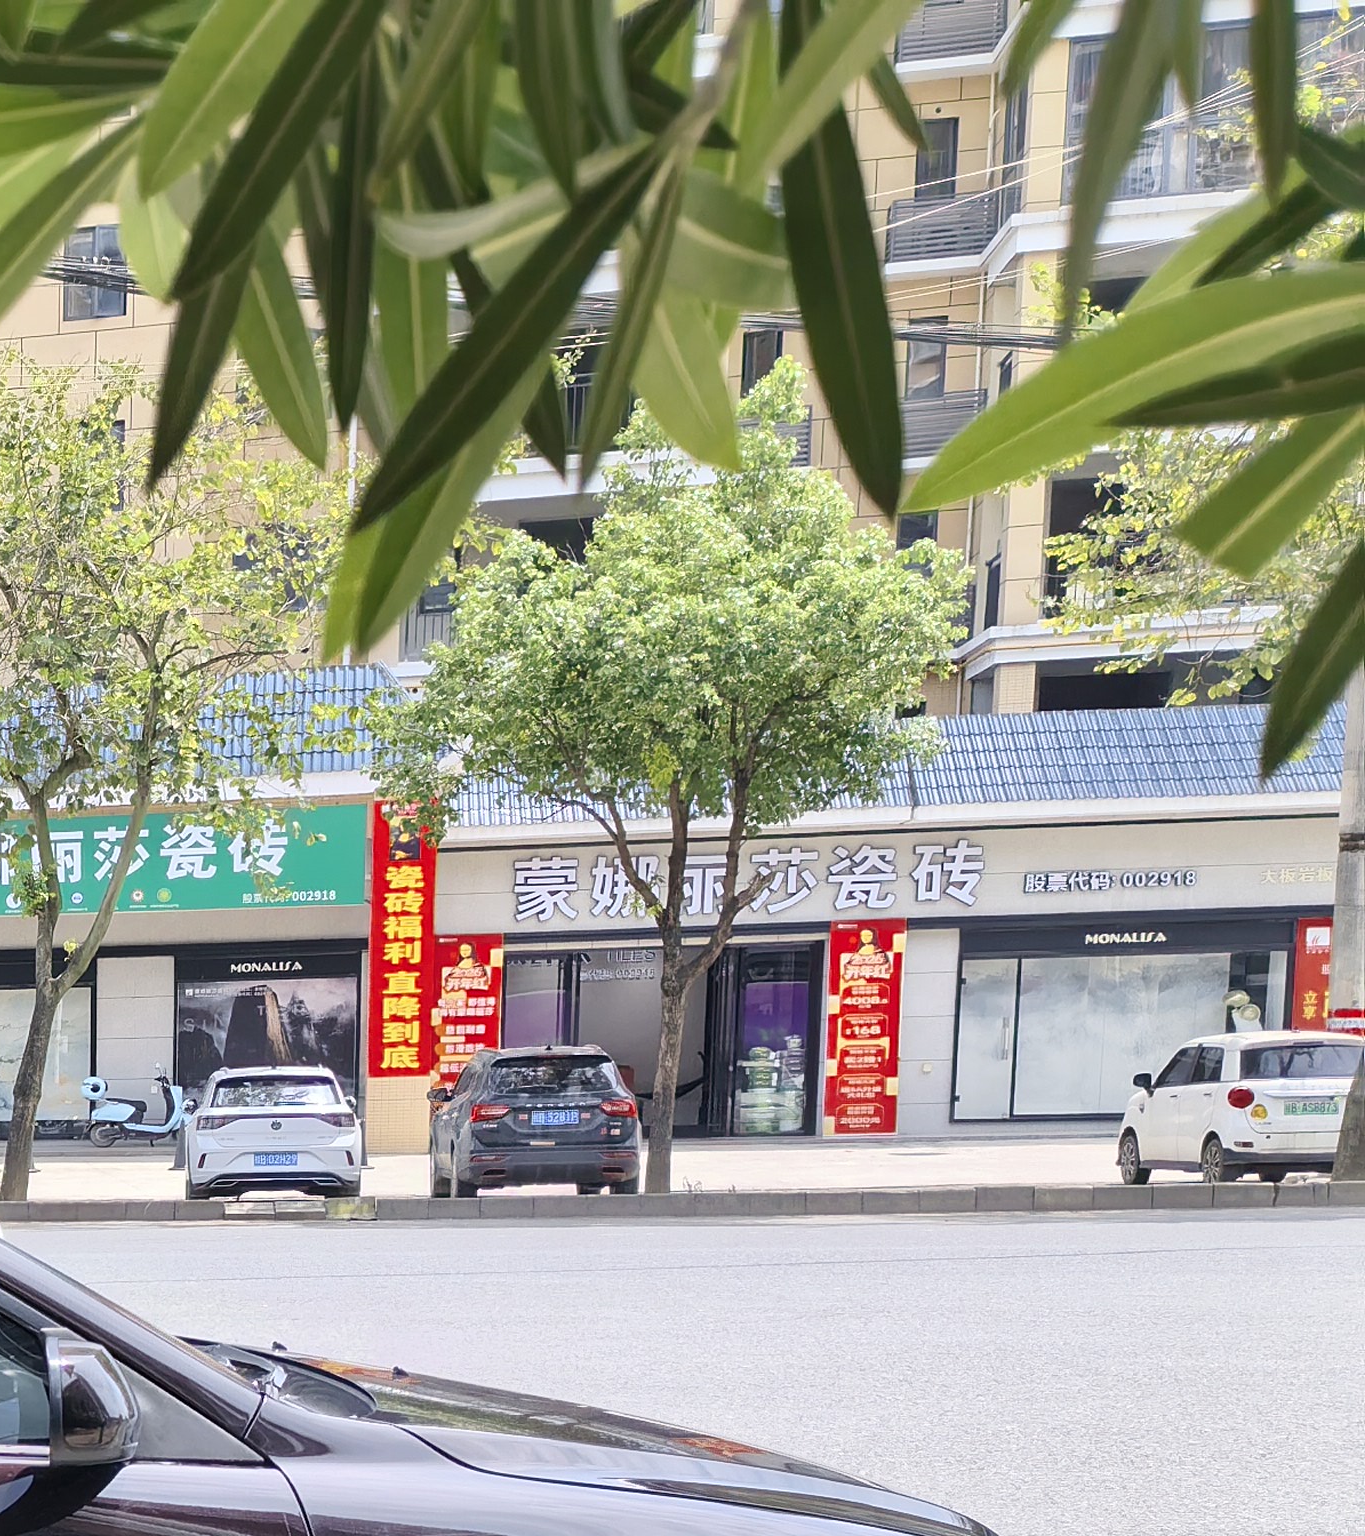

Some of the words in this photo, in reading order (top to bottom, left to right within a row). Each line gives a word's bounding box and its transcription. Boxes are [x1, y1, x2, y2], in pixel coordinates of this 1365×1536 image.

[242, 890, 336, 904] 股票:002918
[513, 839, 986, 922] 蒙娜丽莎瓷砖
[383, 865, 425, 965] 瓷砖福利
[1085, 932, 1167, 944] MONALISA
[230, 961, 303, 973] MONALISA
[380, 971, 423, 1070] 直降到底
